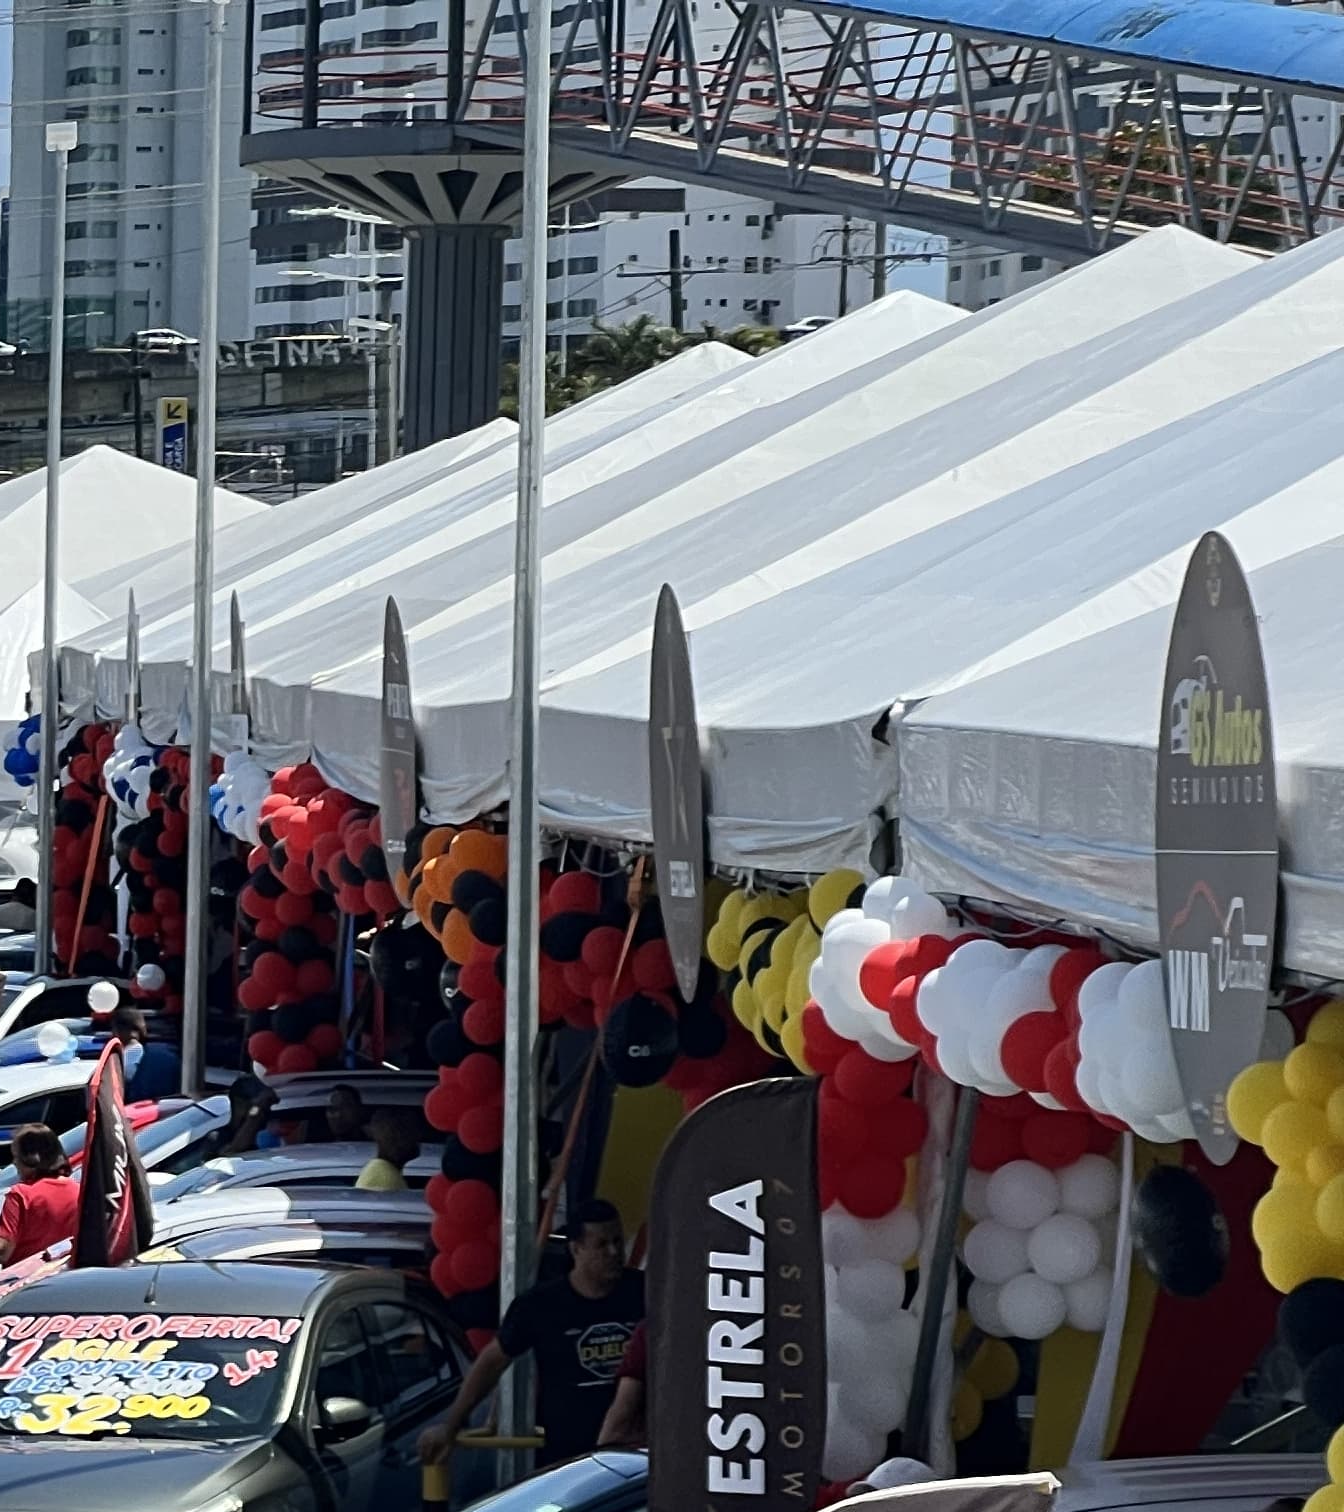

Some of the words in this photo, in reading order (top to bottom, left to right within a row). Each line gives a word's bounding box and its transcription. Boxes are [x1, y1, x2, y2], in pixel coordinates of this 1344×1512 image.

[707, 1178, 767, 1496] ESTRELA
[40, 1338, 179, 1361] AGILE
[25, 1360, 220, 1383] COMPLETO
